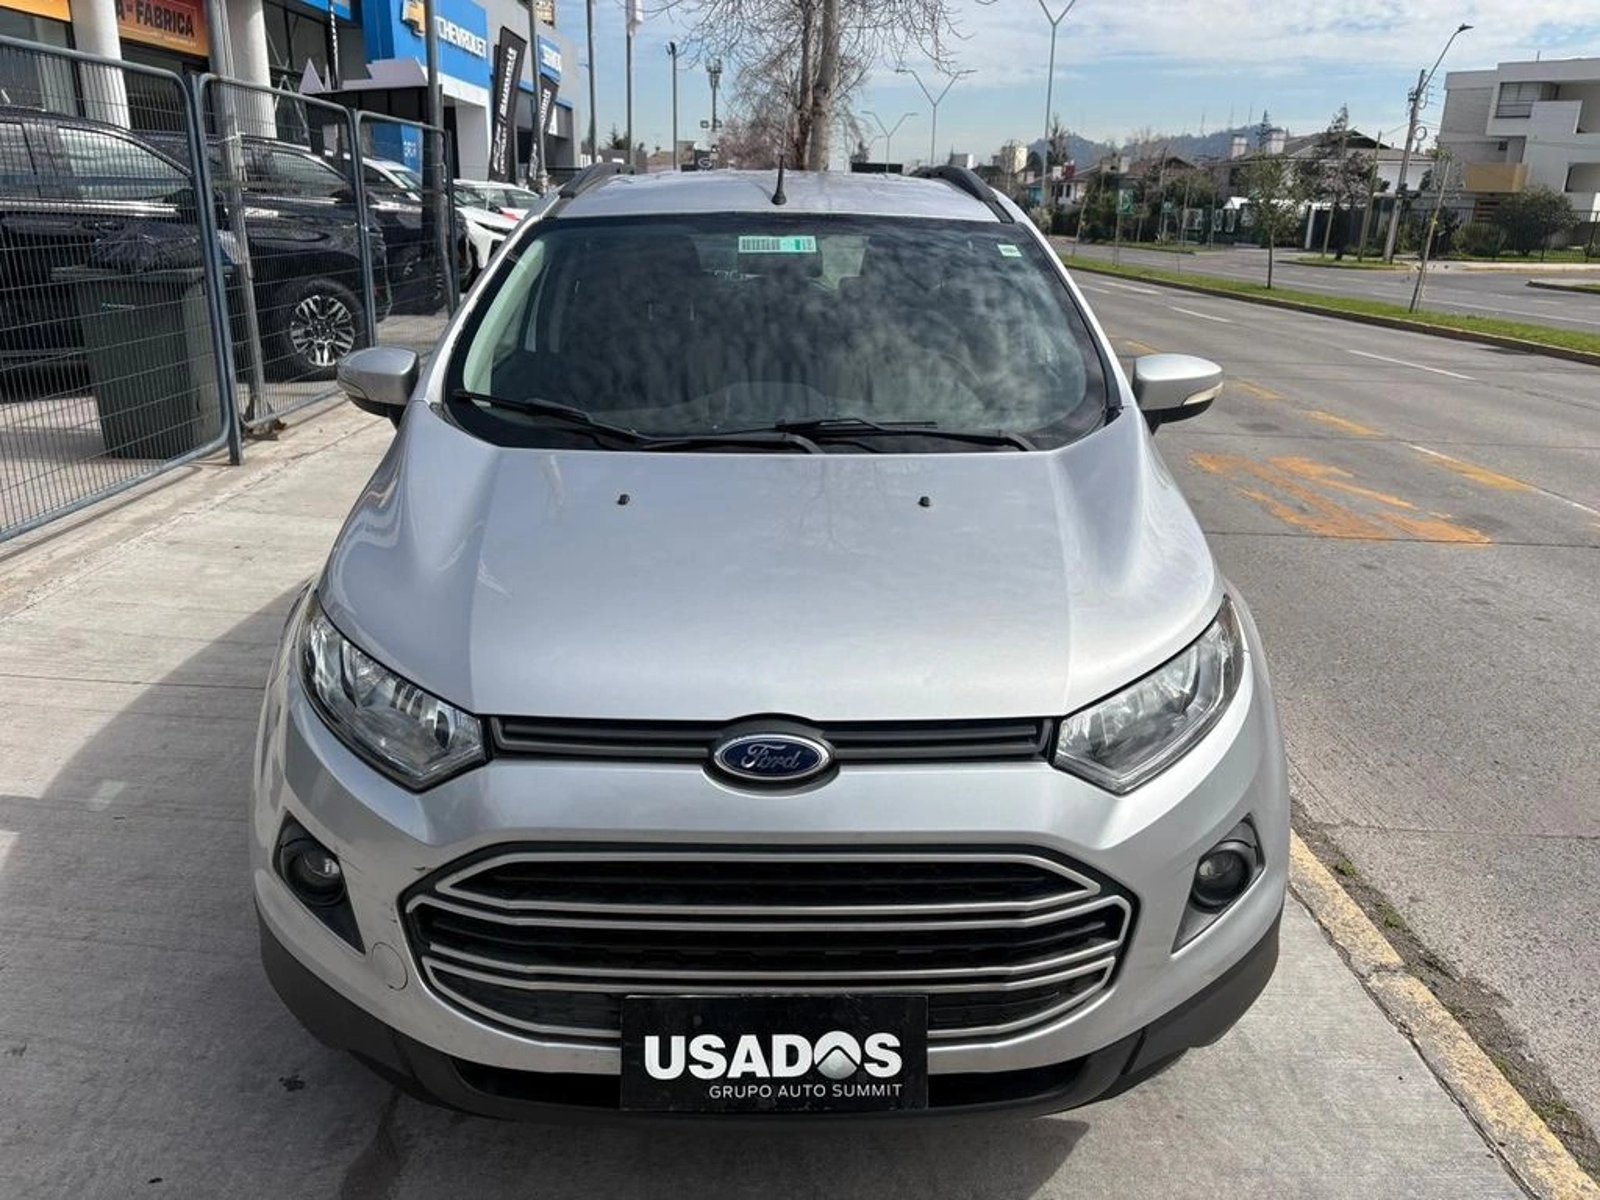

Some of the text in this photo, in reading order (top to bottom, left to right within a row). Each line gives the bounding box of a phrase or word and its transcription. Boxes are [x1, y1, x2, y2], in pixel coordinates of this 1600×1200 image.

[435, 16, 487, 59] CHEVROLET
[741, 743, 801, 769] Ford
[644, 1030, 902, 1080] USADOS
[709, 1083, 902, 1099] GRUPO AUTO SUMMIT
